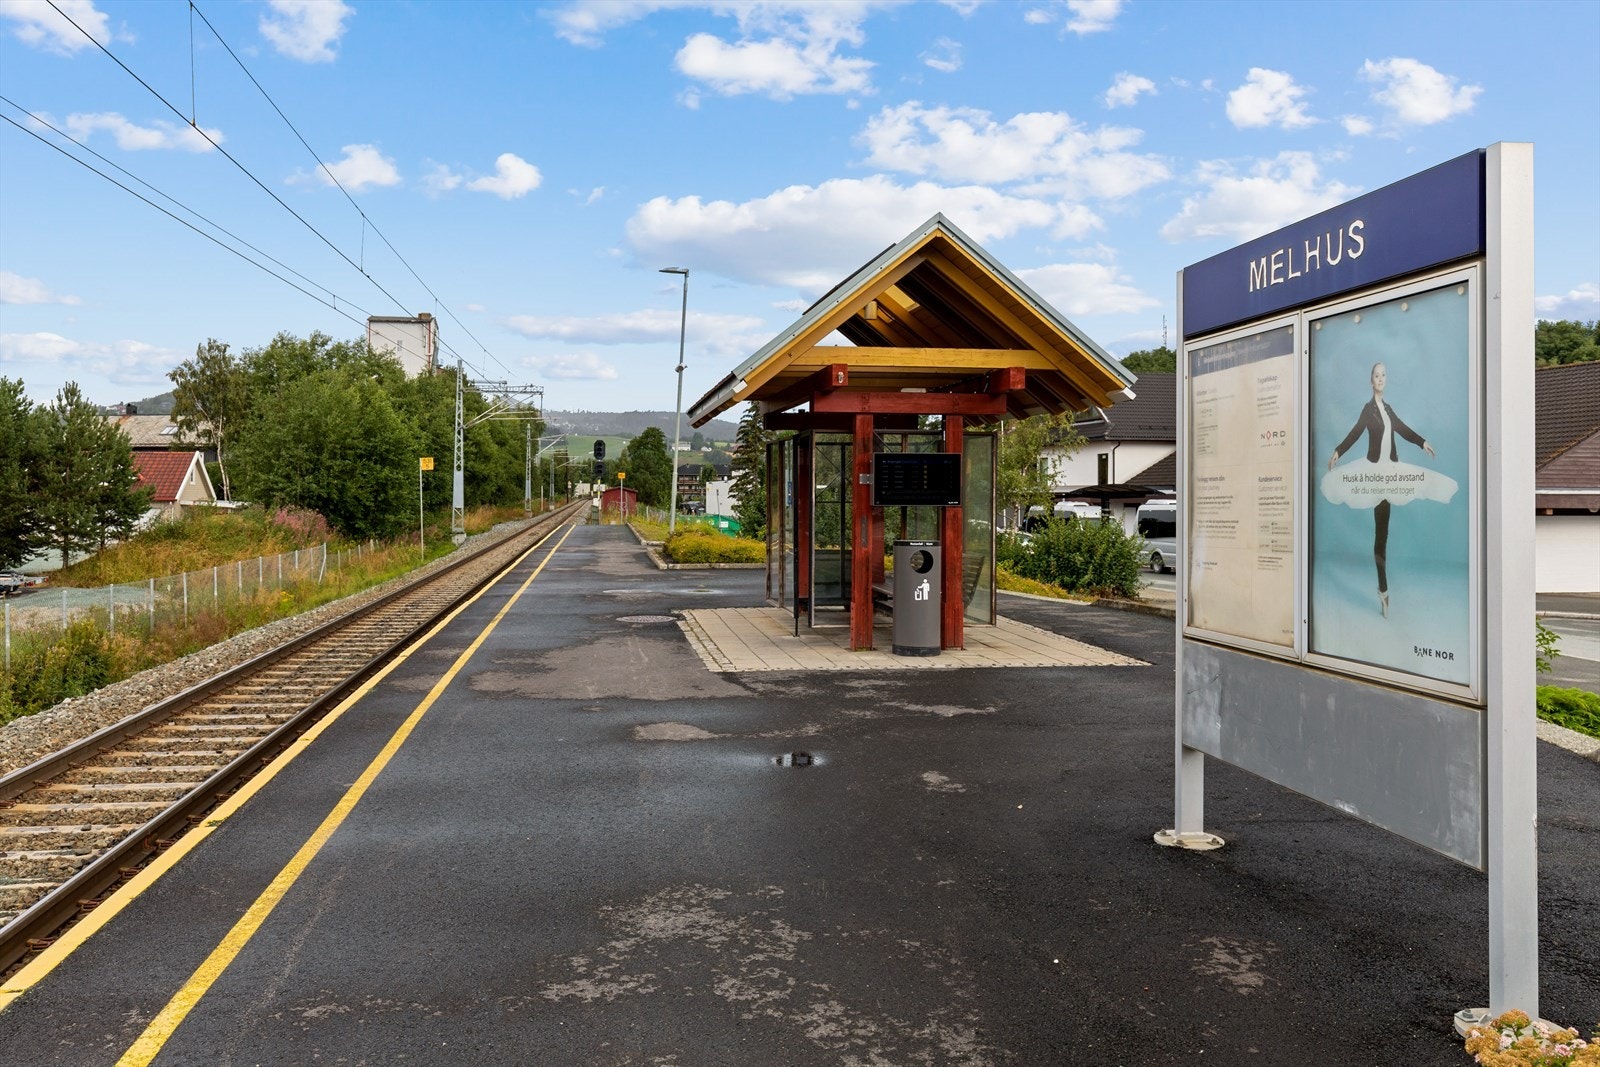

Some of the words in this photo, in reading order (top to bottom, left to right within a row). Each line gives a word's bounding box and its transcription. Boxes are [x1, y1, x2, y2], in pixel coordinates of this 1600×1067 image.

[1249, 219, 1365, 293] MELHUS
[1260, 430, 1286, 440] NORD
[1343, 474, 1358, 483] Husk
[1360, 473, 1364, 482] å
[1365, 473, 1384, 482] holde
[1385, 472, 1397, 484] god
[1399, 472, 1425, 482] avstand
[1351, 486, 1360, 494] når
[1399, 487, 1415, 496] toget
[1414, 645, 1432, 658] BANE
[1435, 650, 1454, 661] NOR
